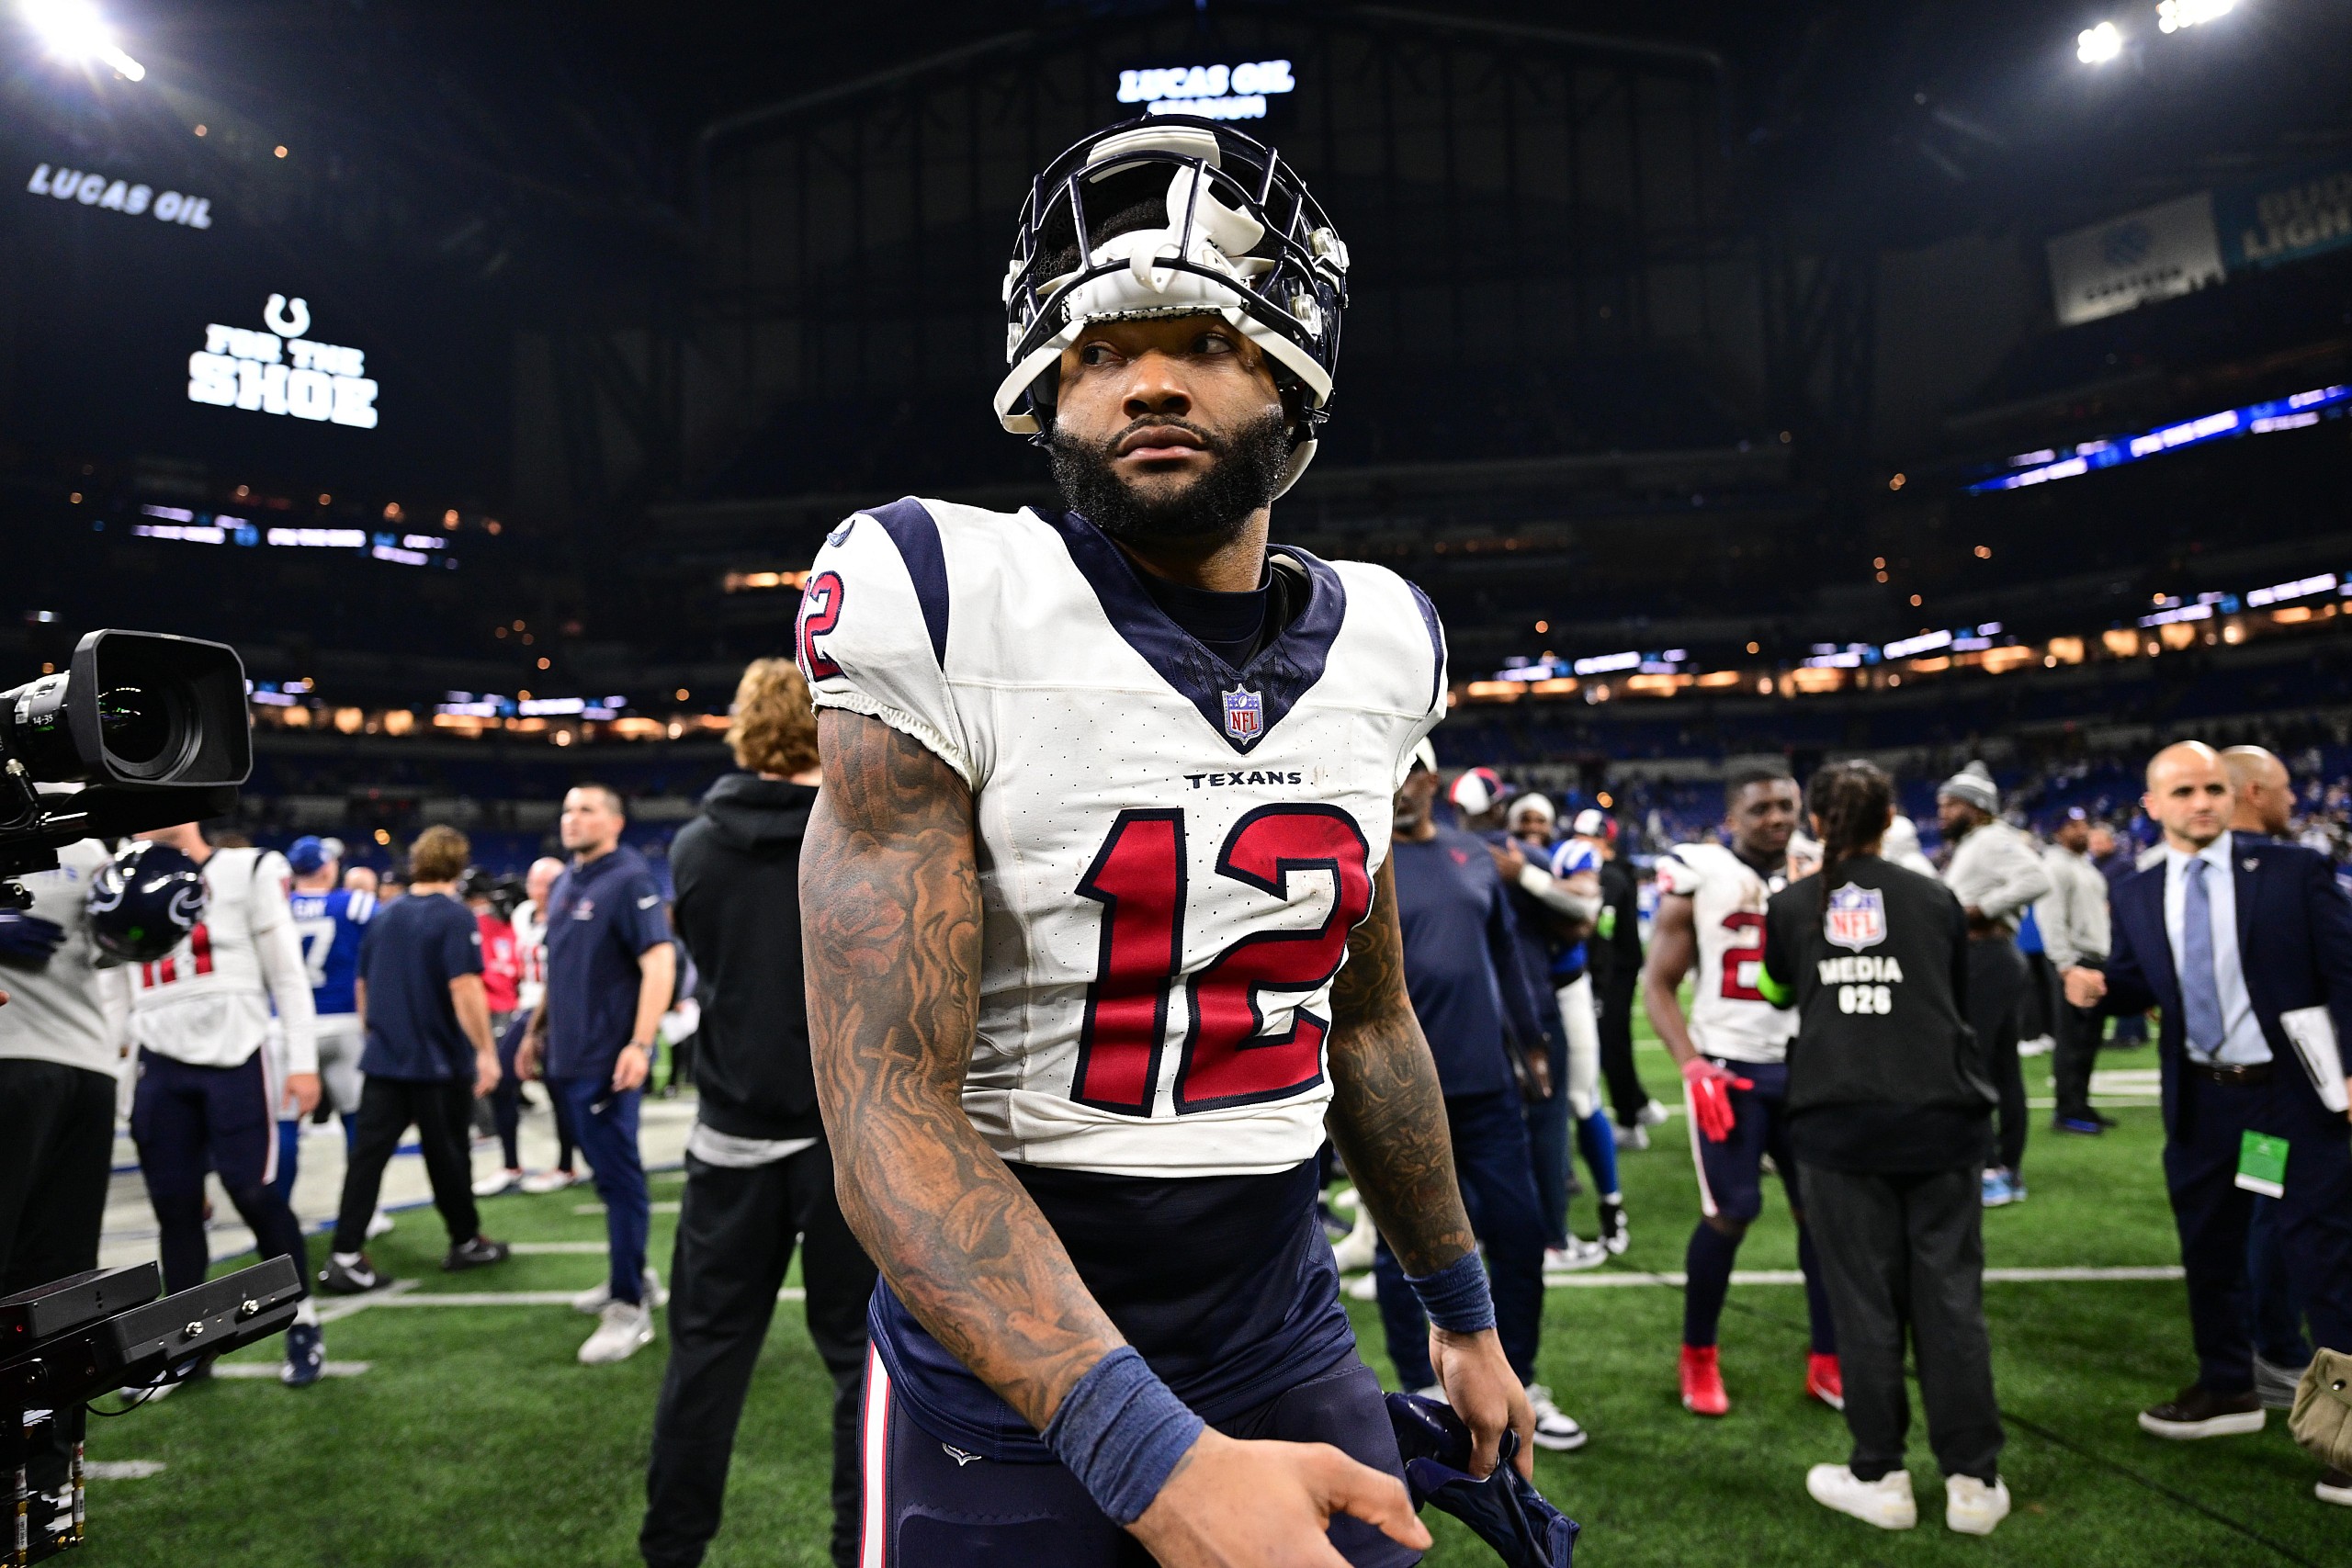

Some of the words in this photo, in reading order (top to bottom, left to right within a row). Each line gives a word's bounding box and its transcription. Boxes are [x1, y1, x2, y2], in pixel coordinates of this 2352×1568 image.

[1116, 65, 1230, 103] LUCAS
[1231, 60, 1295, 96] OIL
[27, 163, 153, 215] LUCAS
[153, 190, 212, 230] OIL
[287, 338, 365, 378] THE
[187, 351, 379, 429] SHOE
[1231, 711, 1258, 733] NFL
[1183, 772, 1302, 789] TEXANS
[1831, 910, 1879, 939] NFL
[1070, 803, 1374, 1118] 12
[1817, 956, 1904, 986] MEDIA
